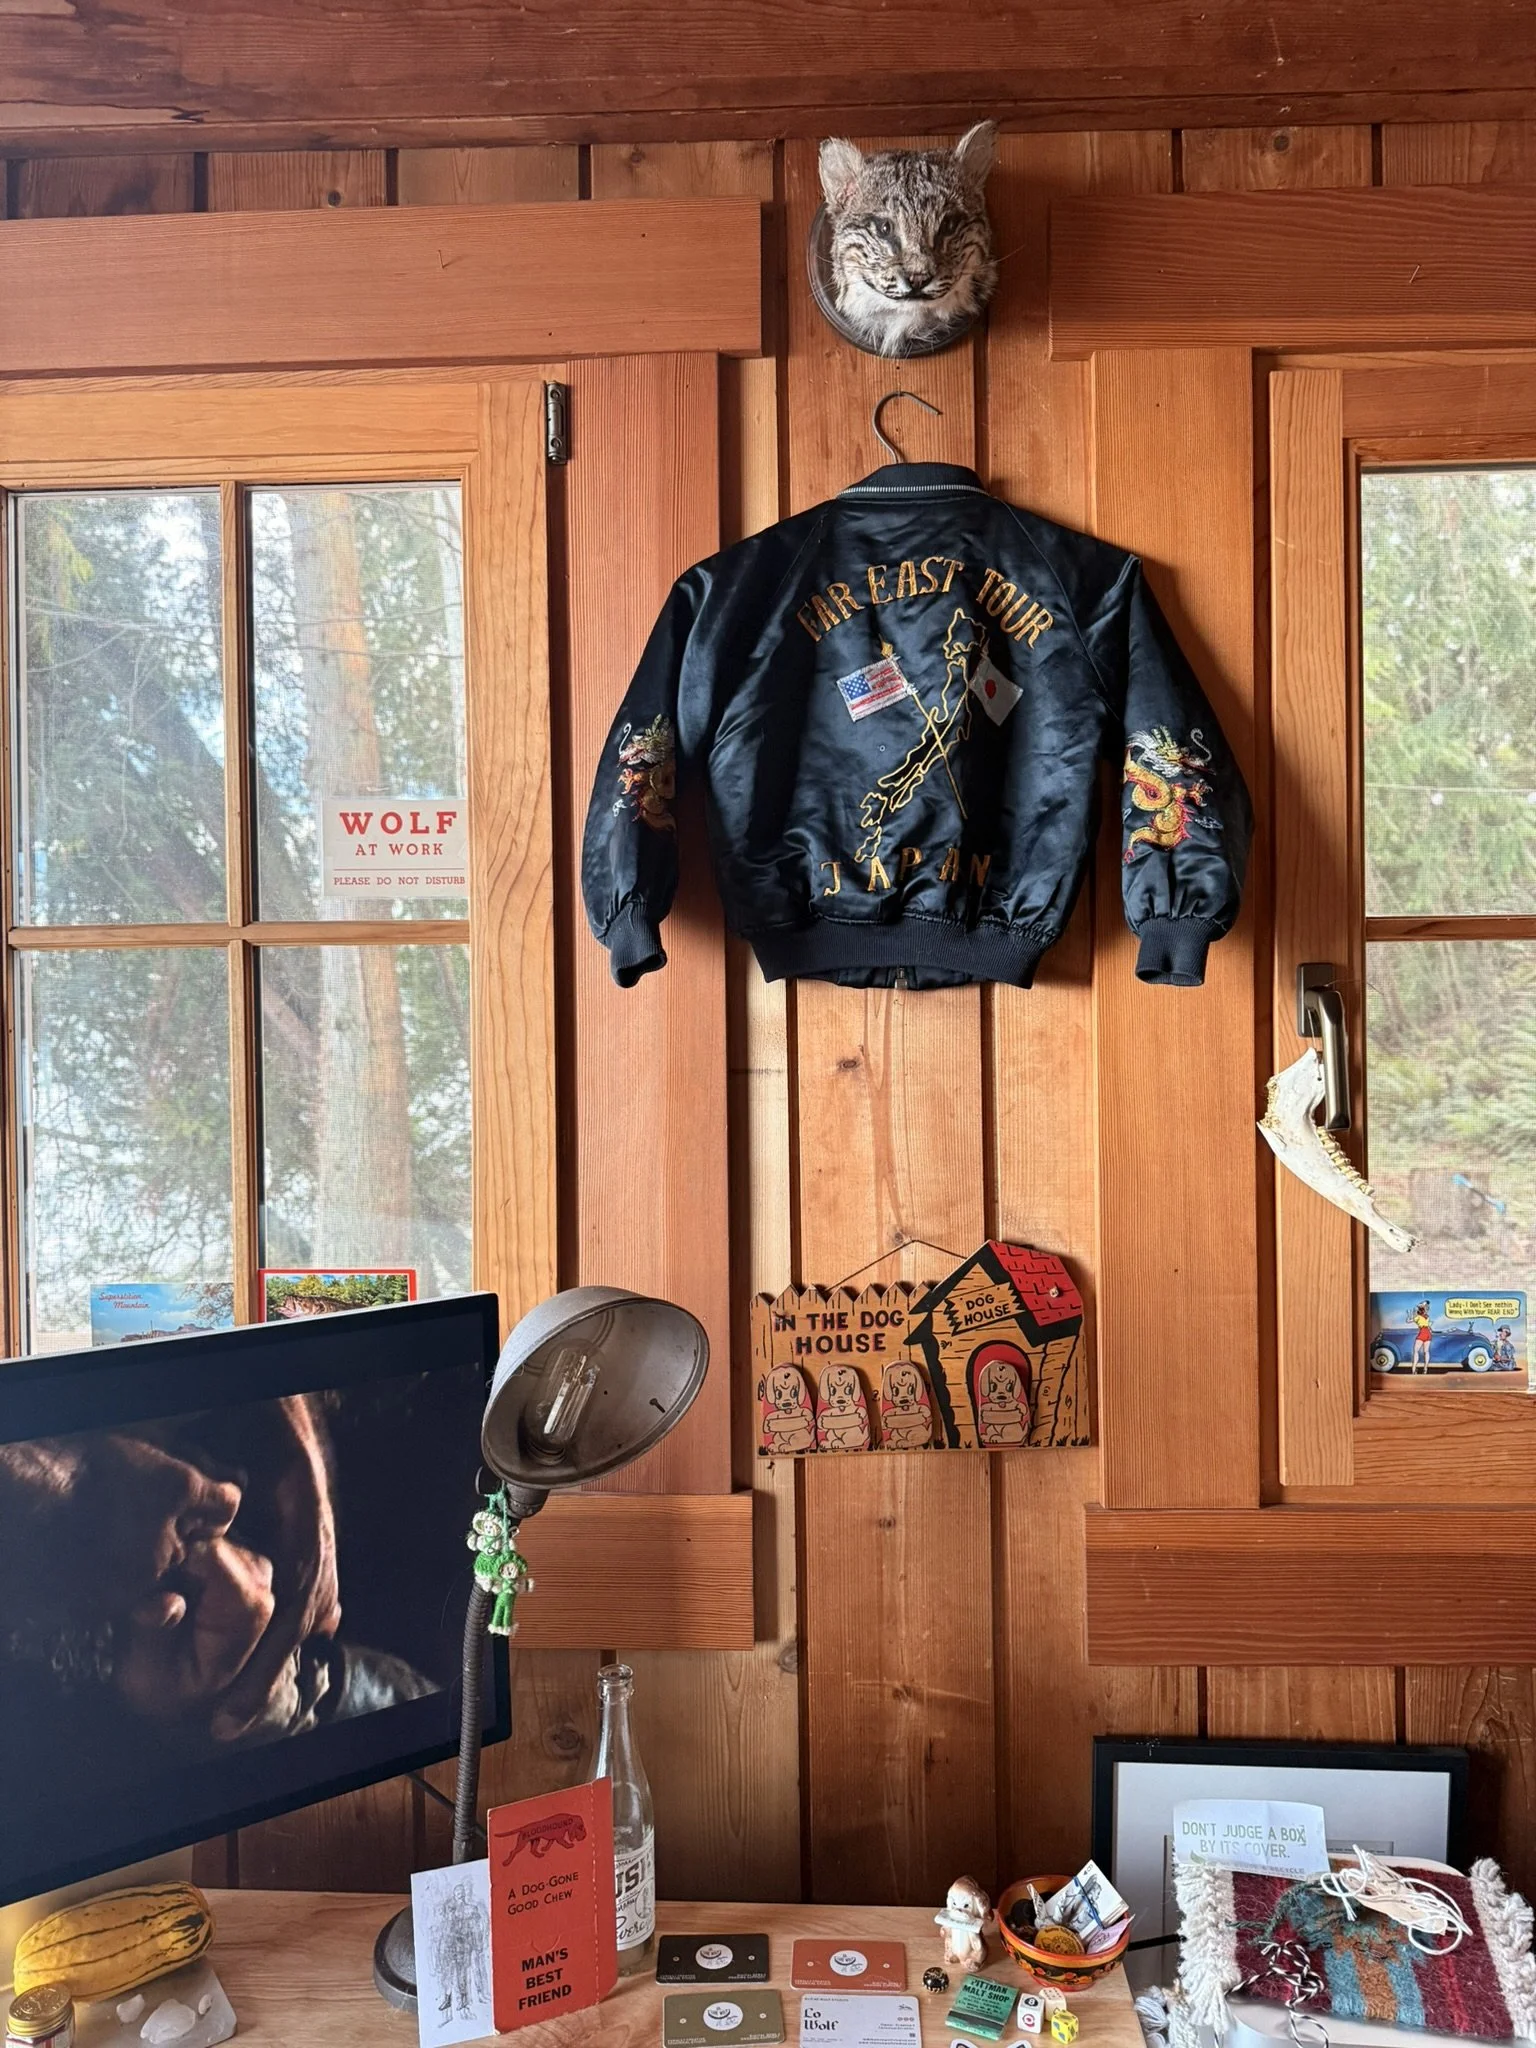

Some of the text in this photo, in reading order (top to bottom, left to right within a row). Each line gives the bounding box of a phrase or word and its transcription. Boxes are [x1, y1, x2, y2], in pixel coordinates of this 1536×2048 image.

[797, 556, 1054, 649] FAR EAST TOUR
[339, 811, 457, 835] WOLF
[355, 843, 443, 856] AT WORK
[334, 876, 465, 886] PLEASE DO NOT DISTURB
[820, 847, 992, 896] JAPAN
[113, 1301, 151, 1309] Mountain
[965, 1294, 995, 1309] DOG
[775, 1310, 905, 1332] IN THE DOG
[964, 1304, 1012, 1326] HOUSE
[795, 1333, 886, 1355] HOUSE
[522, 1818, 574, 1840] BLOODHOUND
[1182, 1821, 1306, 1845] DON'T JUDGE A BOX
[1200, 1839, 1290, 1859] BY ITS COVER.
[507, 1888, 516, 1900] A
[522, 1948, 569, 1972] MAN'S
[526, 1968, 563, 1990] BEST
[518, 1984, 572, 2010] FRIEND
[962, 1984, 1010, 2003] MALT SHOP
[804, 2019, 839, 2031] Wolf
